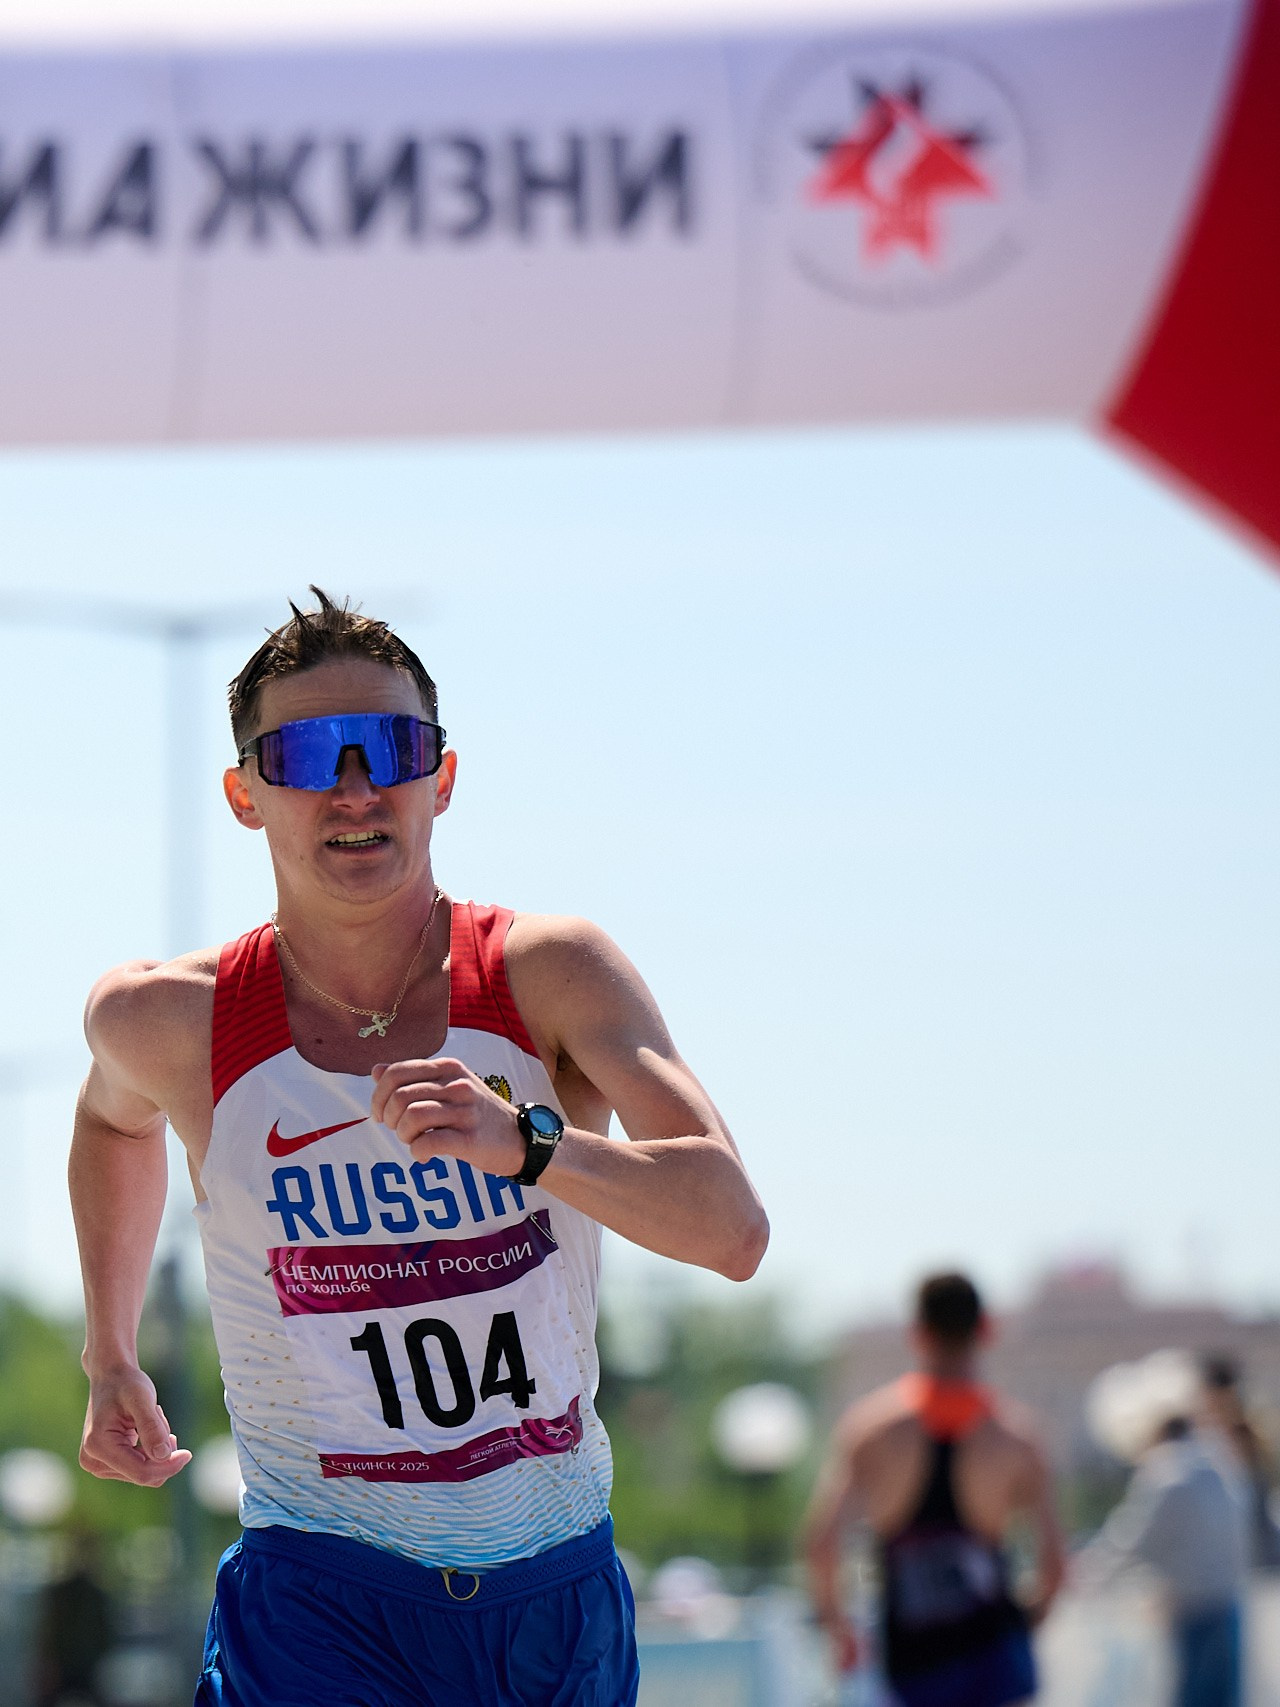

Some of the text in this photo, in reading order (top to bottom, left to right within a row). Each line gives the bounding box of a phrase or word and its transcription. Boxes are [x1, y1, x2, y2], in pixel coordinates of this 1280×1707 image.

[190, 126, 698, 252] ЖИЗНИ
[266, 1156, 526, 1241] RUSSIA
[282, 1242, 533, 1281] ЧЕМПИОНАТ РОССИИ
[285, 1280, 371, 1295] по ходьбе
[350, 1311, 536, 1430] 104
[400, 1461, 430, 1471] 2025
